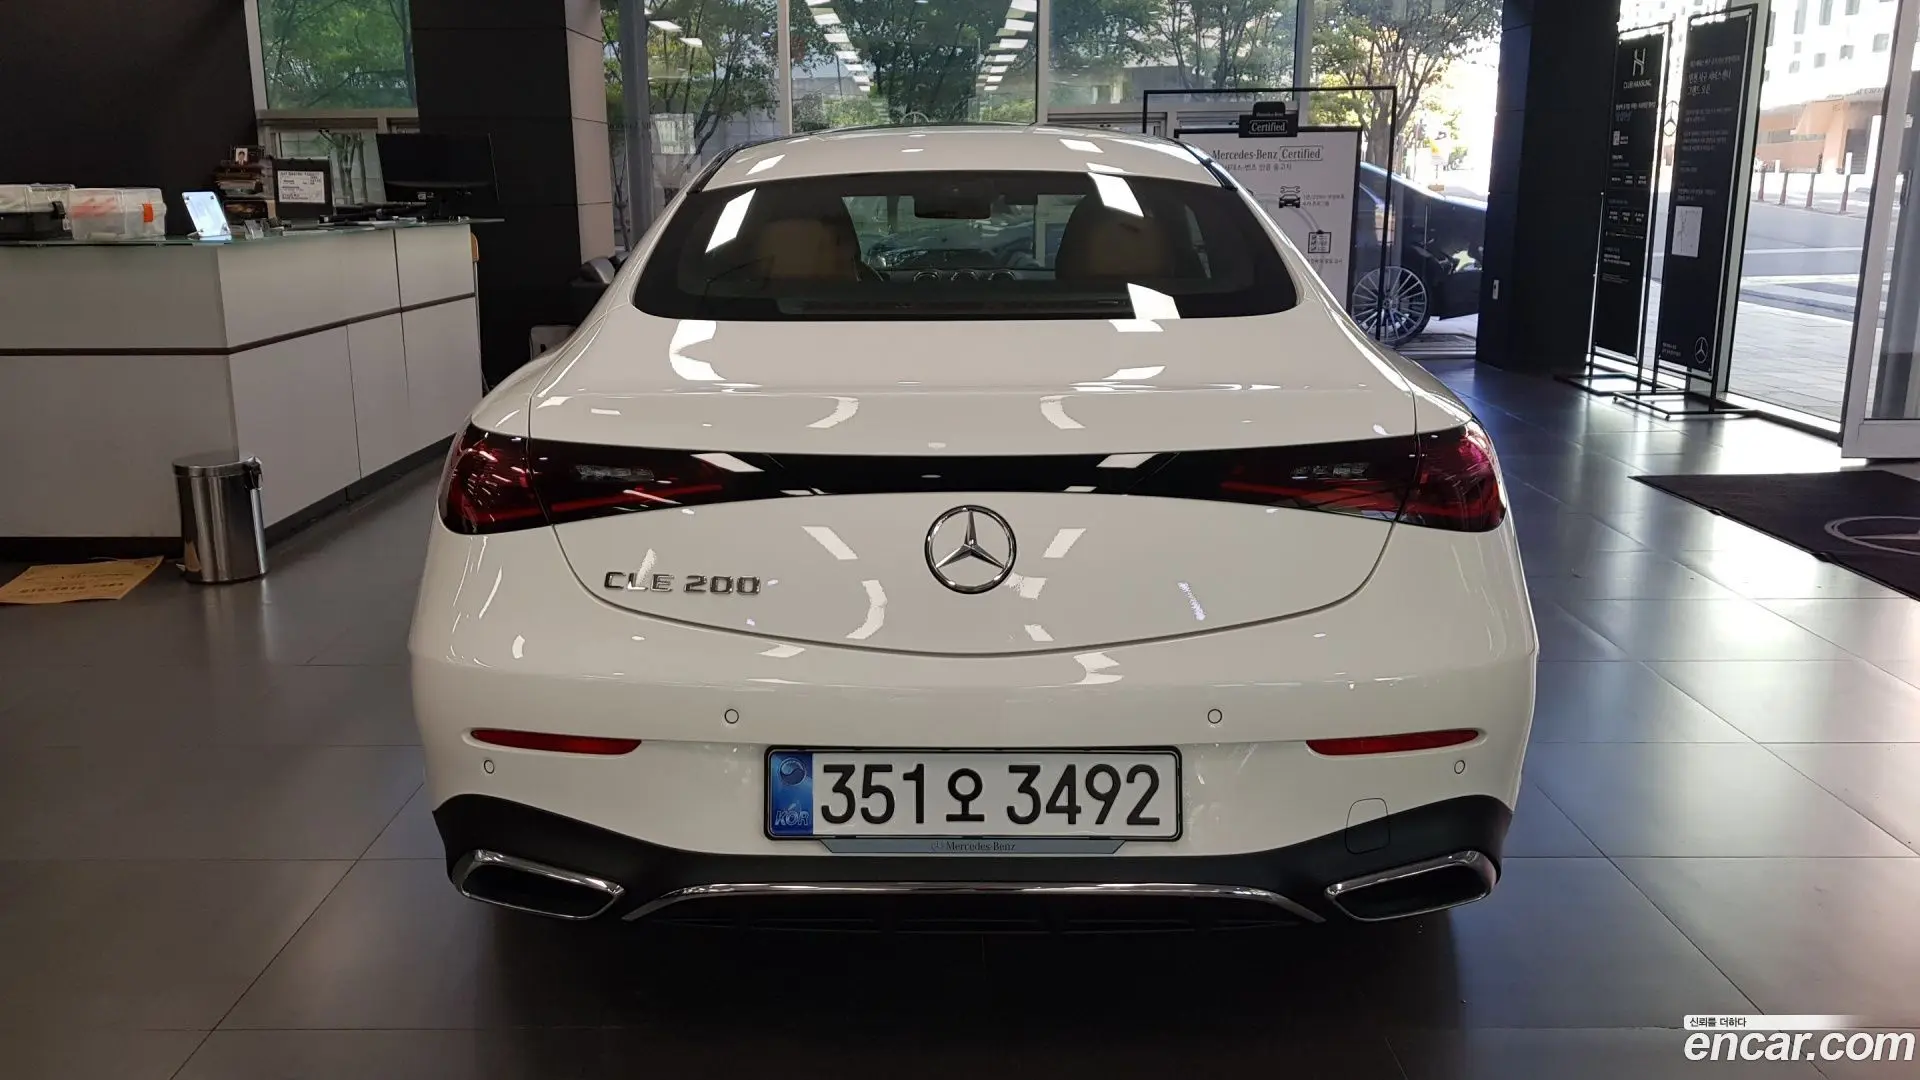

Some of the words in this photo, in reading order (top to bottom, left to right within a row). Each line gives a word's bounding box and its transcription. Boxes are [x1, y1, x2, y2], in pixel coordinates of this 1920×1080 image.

[1251, 121, 1286, 132] Certified
[1211, 149, 1278, 161] Mercedes-Benz
[1281, 148, 1321, 159] Certified
[603, 571, 675, 593] CLE
[683, 574, 761, 595] 200
[820, 763, 926, 825] 351
[945, 767, 985, 823] 오
[1006, 763, 1161, 826] 3492
[774, 809, 809, 827] KOR
[946, 840, 1017, 852] Mercedes-Benz
